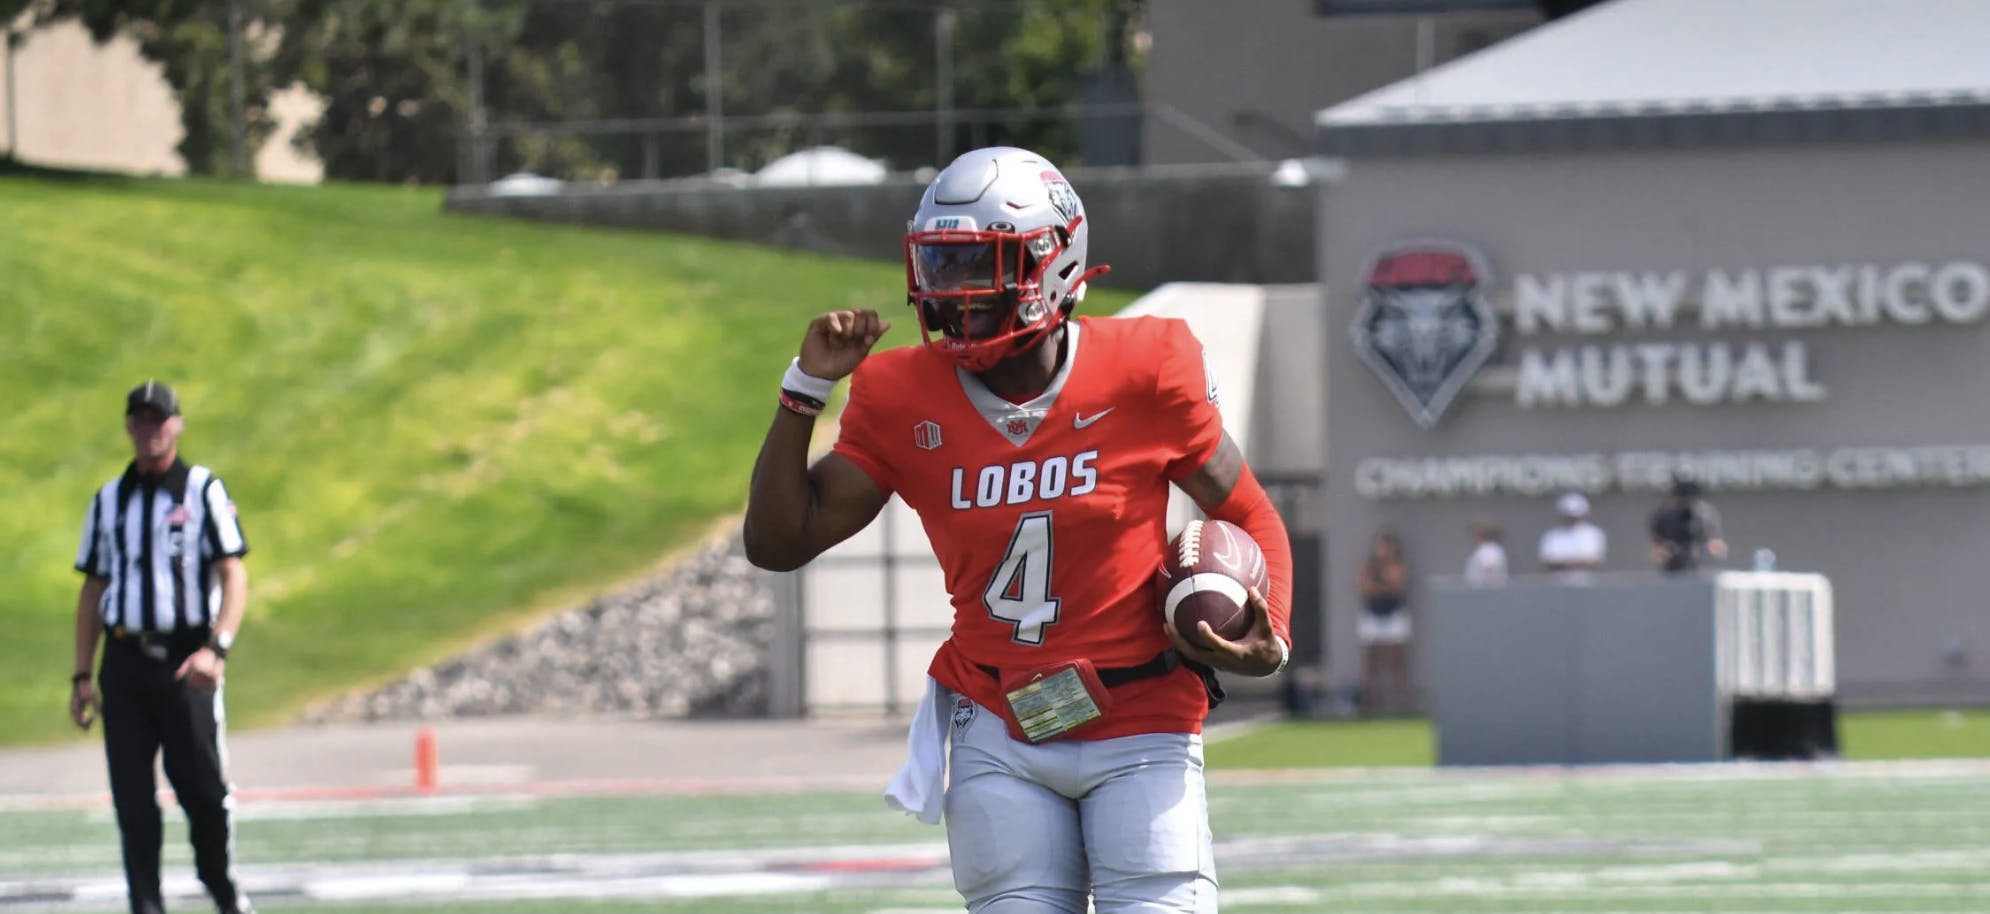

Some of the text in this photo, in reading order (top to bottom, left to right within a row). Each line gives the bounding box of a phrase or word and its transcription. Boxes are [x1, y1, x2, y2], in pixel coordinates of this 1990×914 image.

[1515, 262, 1989, 334] NEW MEXICO
[1515, 342, 1825, 407] MUTUAL
[951, 450, 1098, 510] LOBOS
[983, 510, 1061, 647] 4
